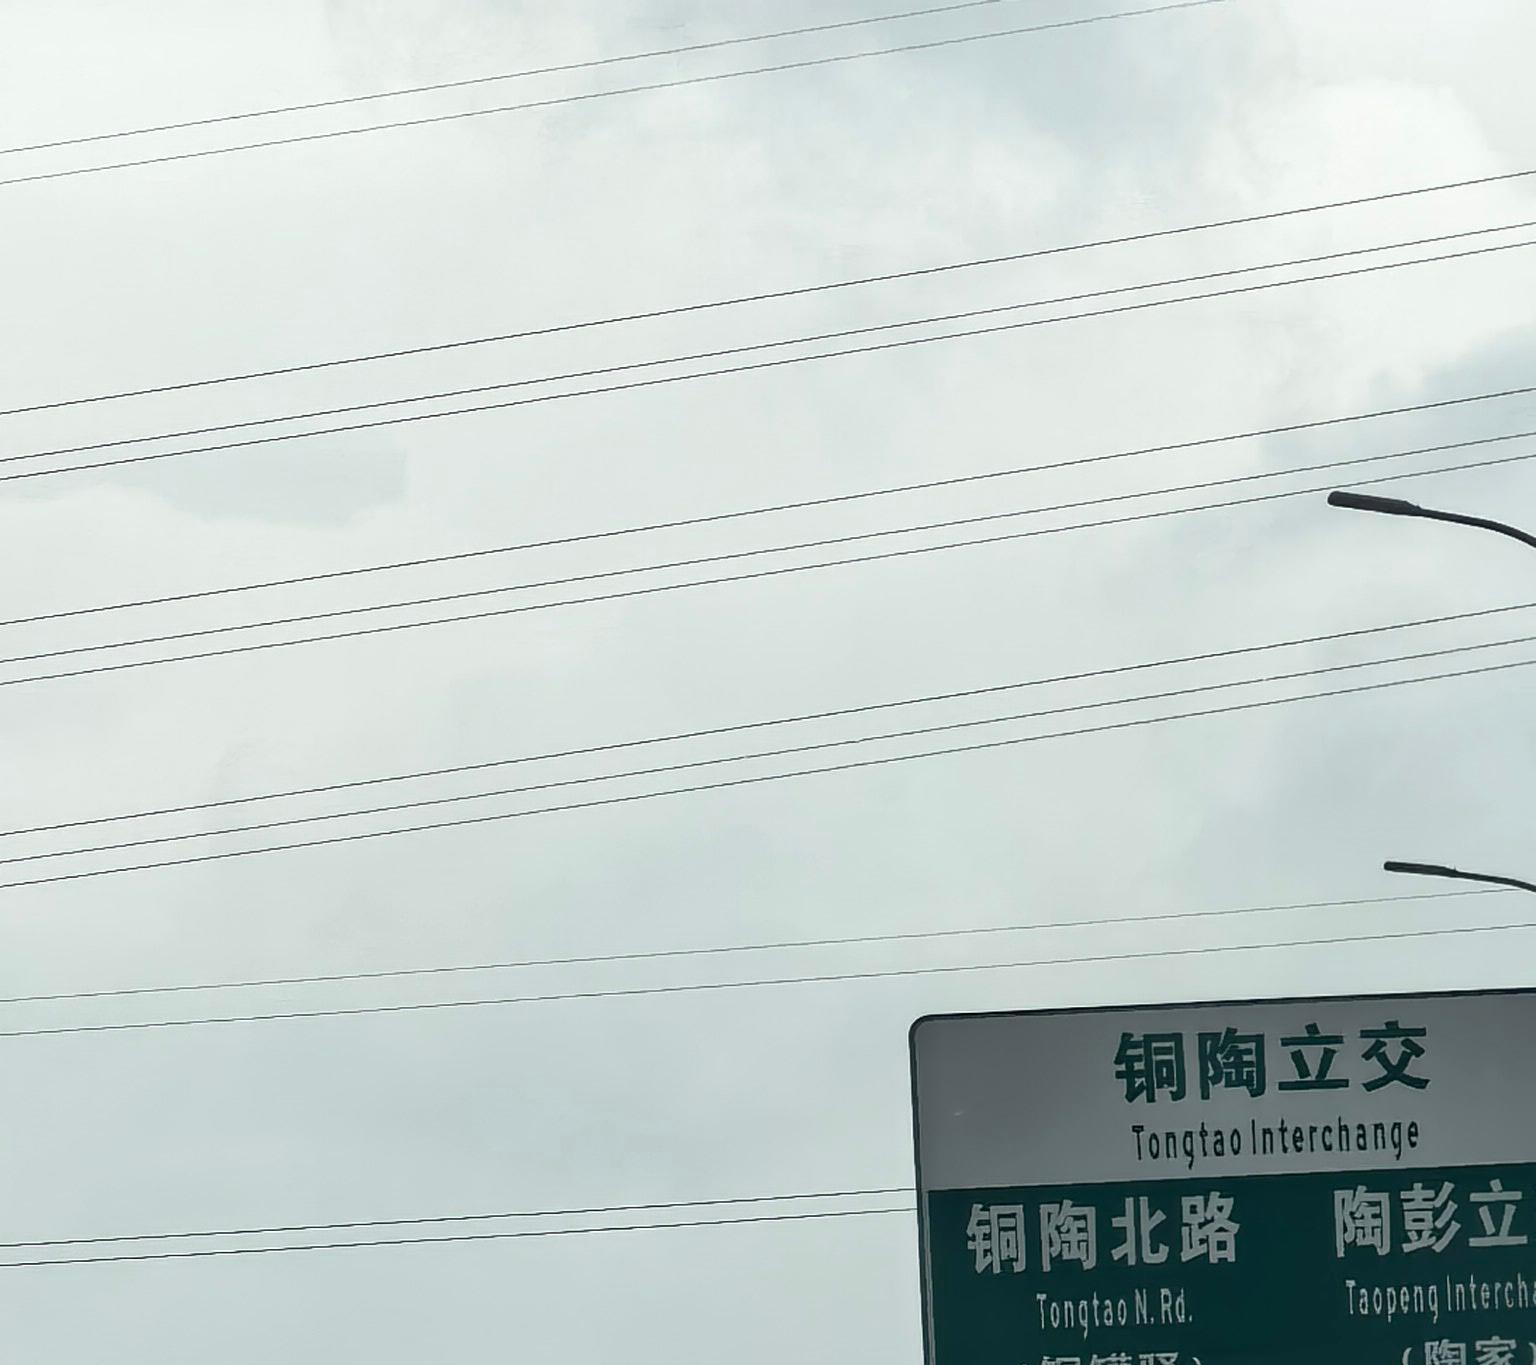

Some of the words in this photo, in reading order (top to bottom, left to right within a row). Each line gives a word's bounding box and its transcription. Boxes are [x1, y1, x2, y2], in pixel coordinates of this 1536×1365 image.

[1114, 1020, 1430, 1103] 铜陶立交
[1131, 1121, 1241, 1170] Tongtao
[1251, 1116, 1419, 1160] Interchange
[966, 1191, 1240, 1274] 铜陶北路
[1333, 1178, 1528, 1258] 陶彭立
[1036, 1292, 1127, 1340] Tongtao
[1345, 1279, 1440, 1324] Taopeng
